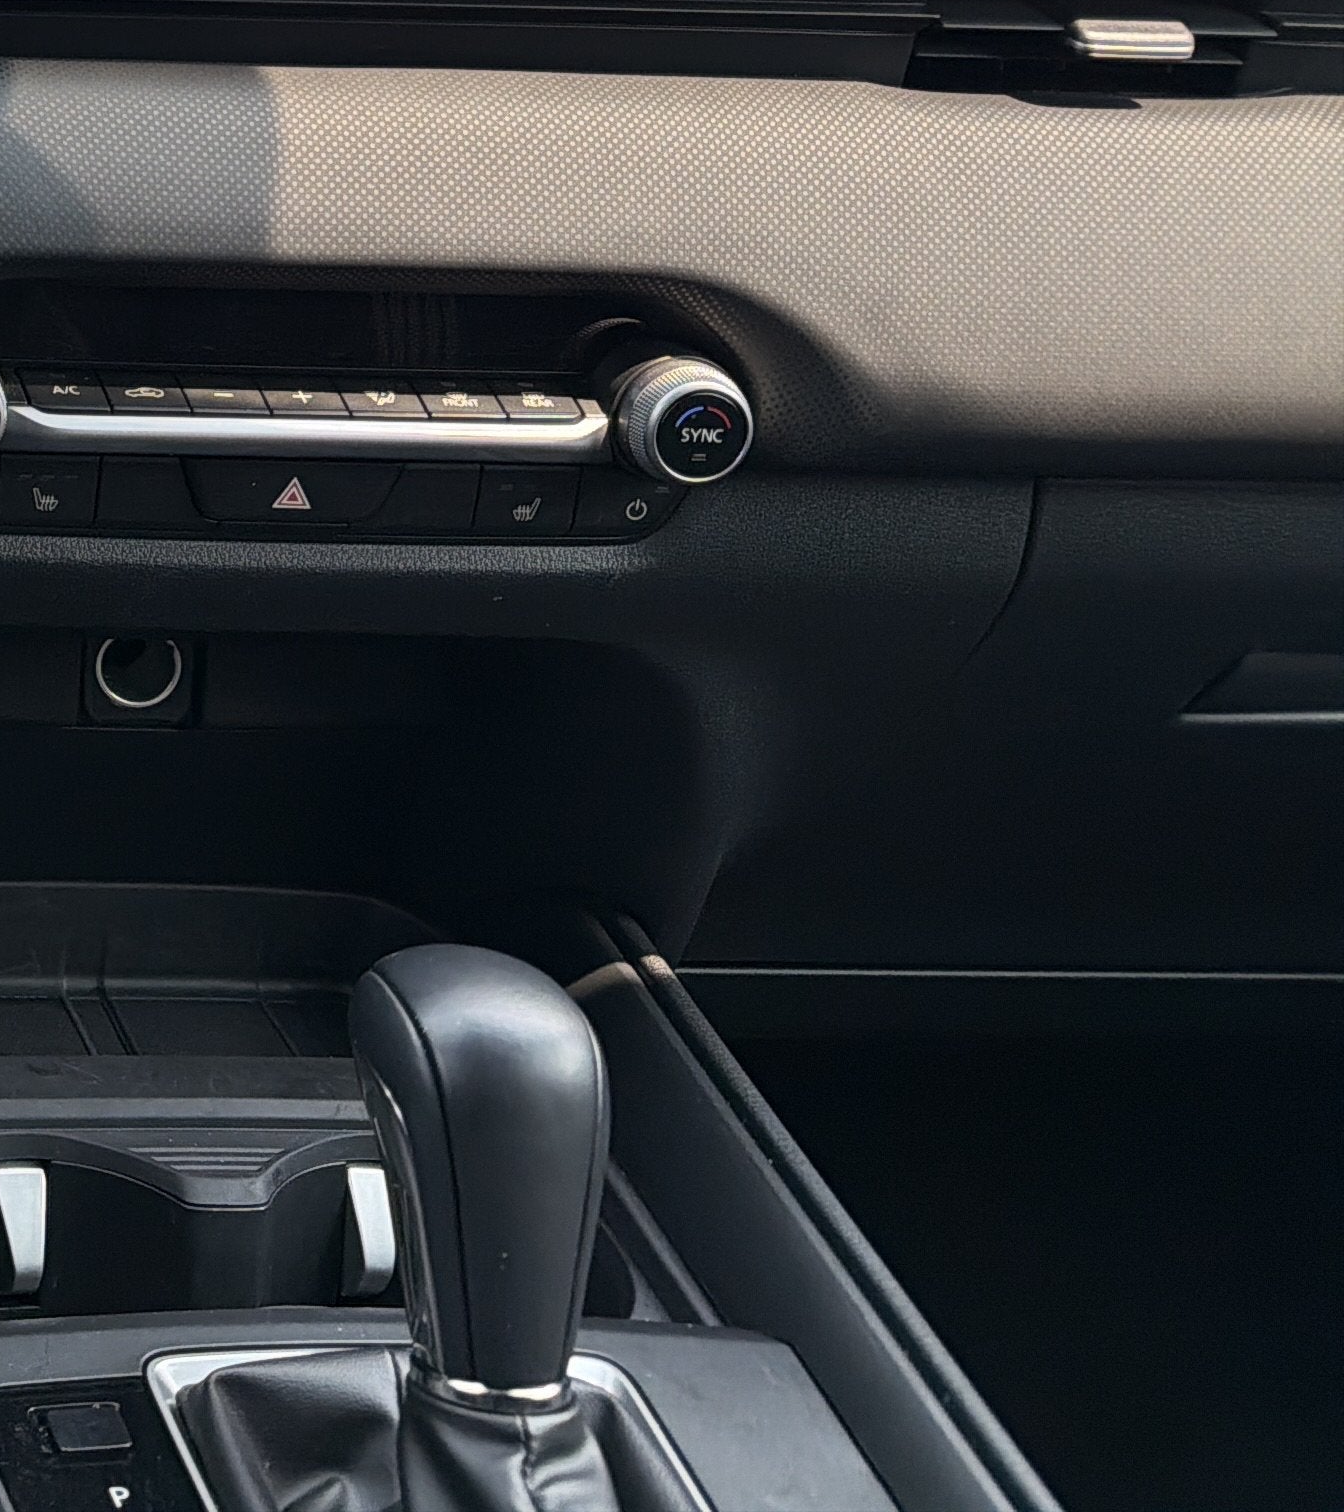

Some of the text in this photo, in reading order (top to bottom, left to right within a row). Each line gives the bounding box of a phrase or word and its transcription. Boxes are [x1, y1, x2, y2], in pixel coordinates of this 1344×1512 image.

[52, 384, 80, 396] A/C
[441, 397, 480, 409] FRONT
[522, 397, 555, 409] REAR
[680, 427, 724, 444] SYNC
[108, 1486, 130, 1507] P
